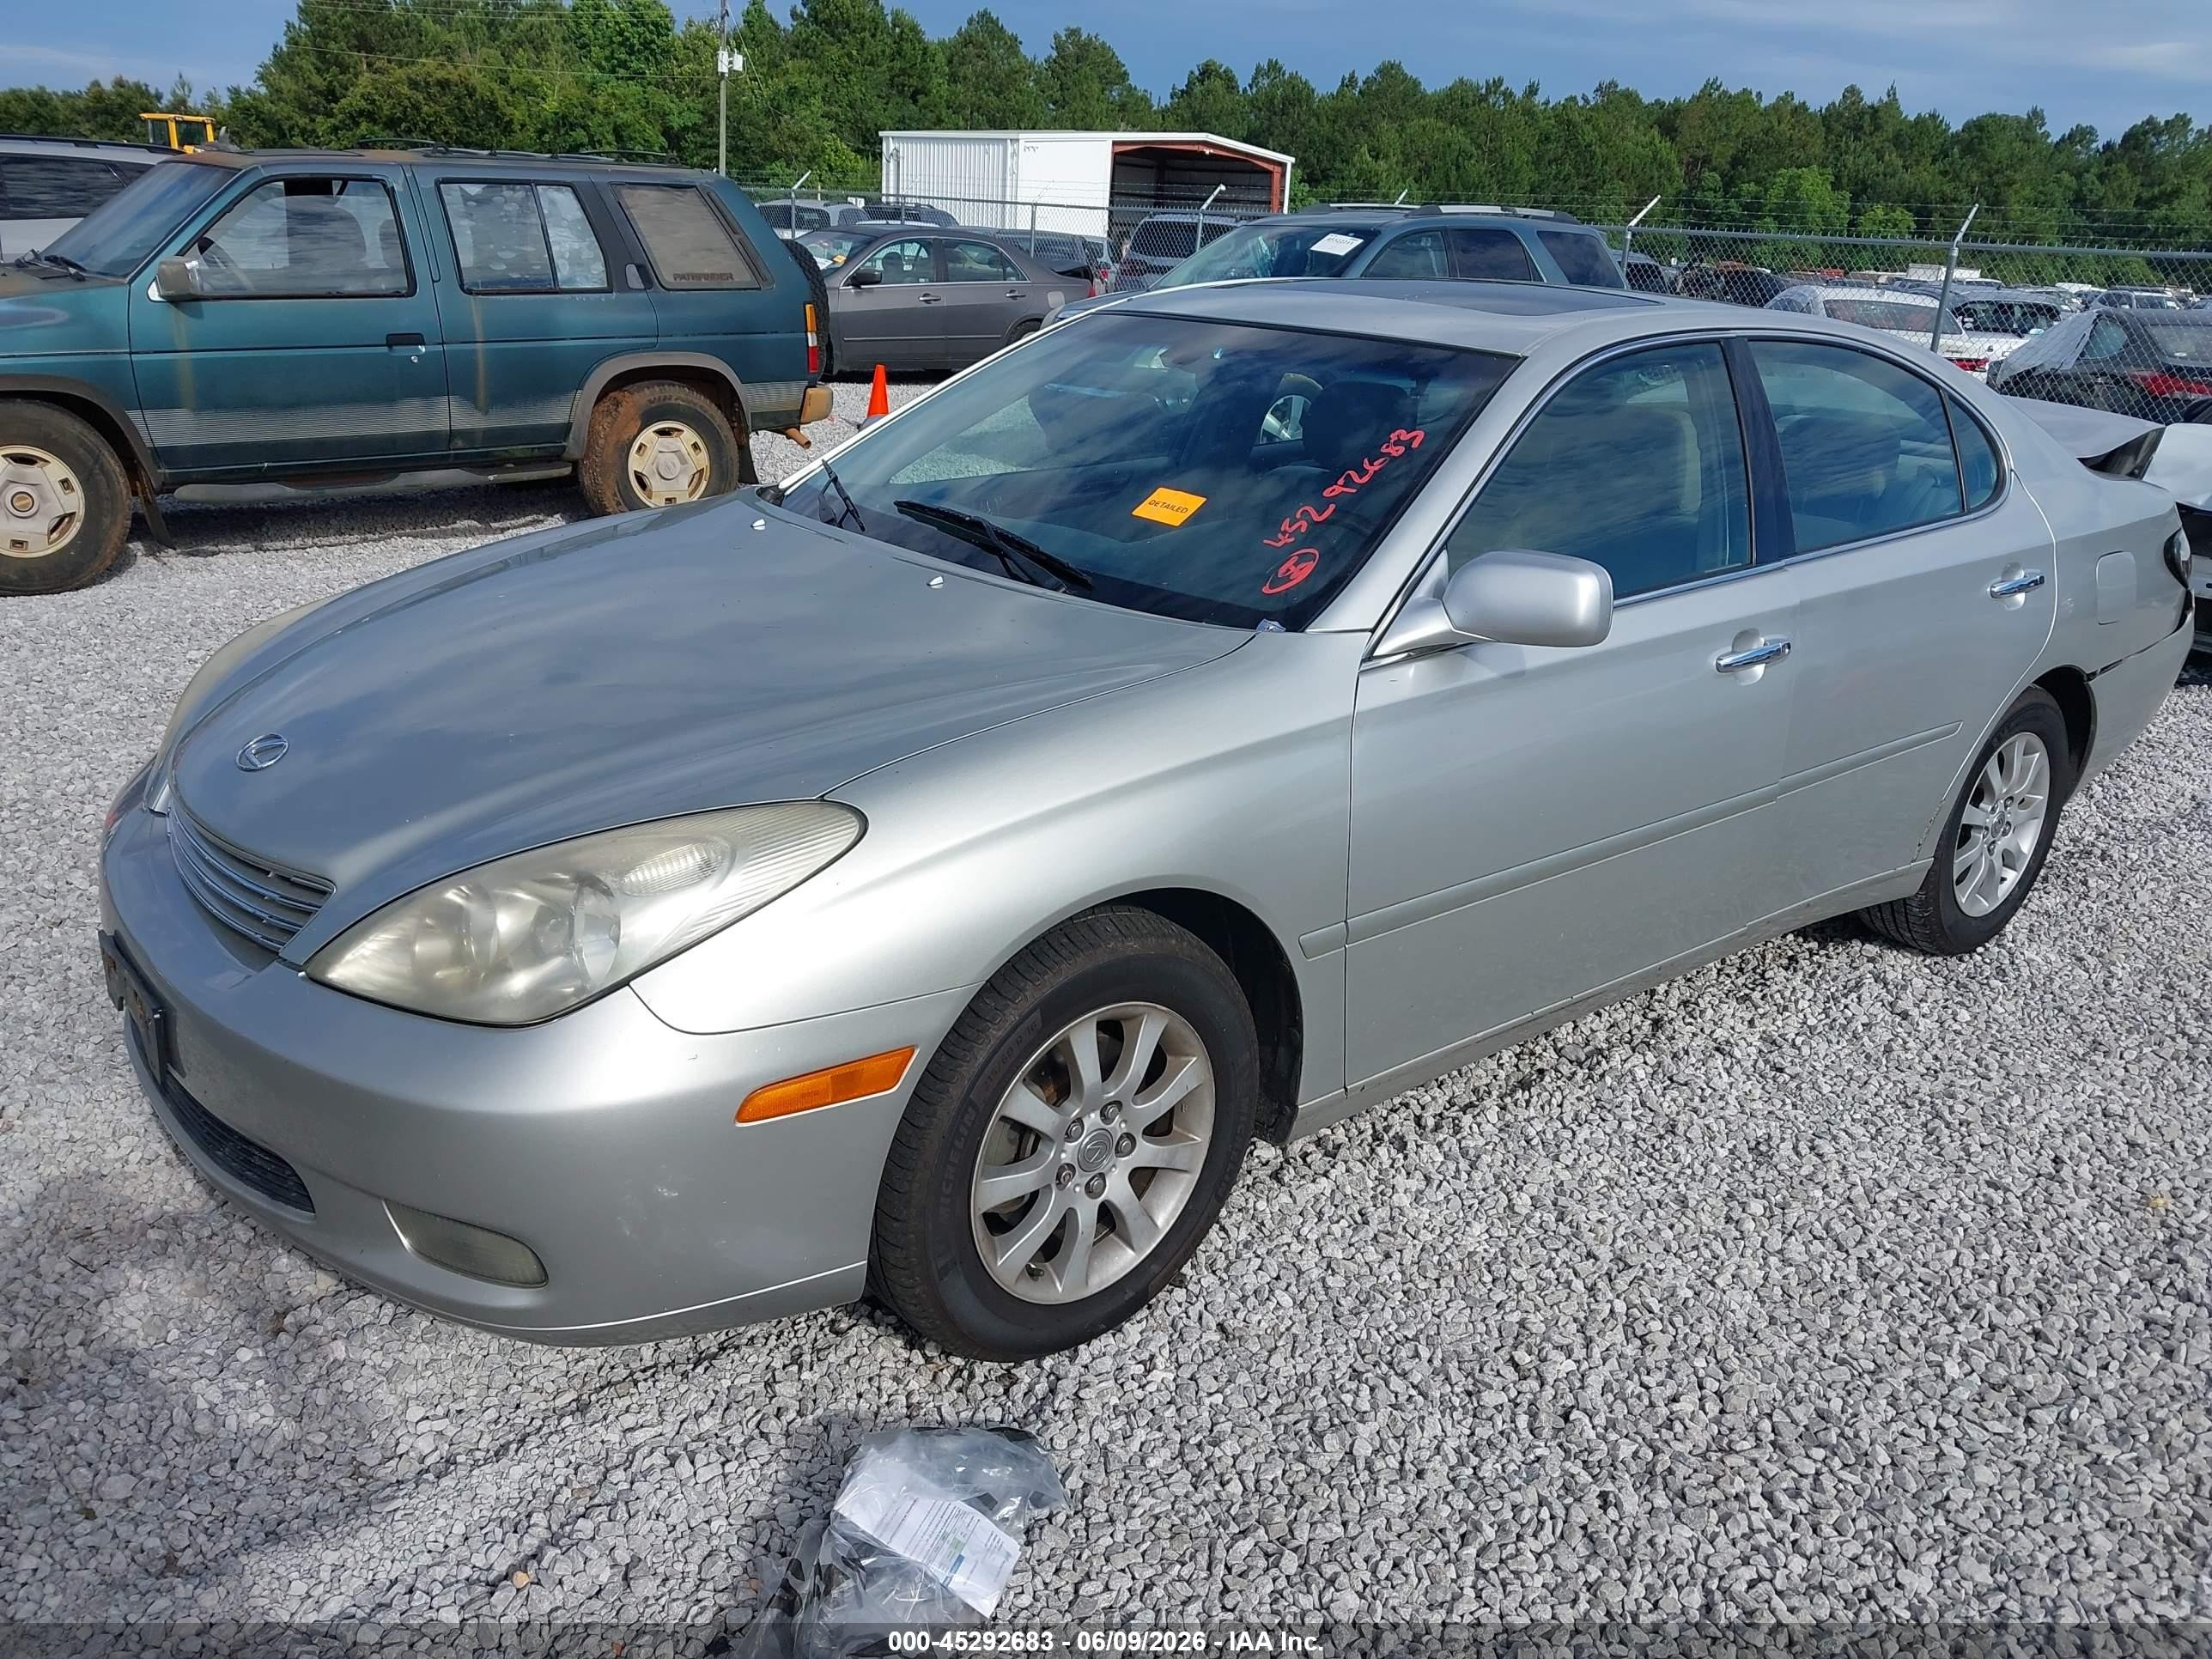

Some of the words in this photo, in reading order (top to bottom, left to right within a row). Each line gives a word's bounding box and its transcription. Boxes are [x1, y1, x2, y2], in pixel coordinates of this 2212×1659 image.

[673, 272, 734, 281] PATHFINDER
[1148, 500, 1188, 514] DETAILED
[939, 1105, 976, 1224] MICHELIN
